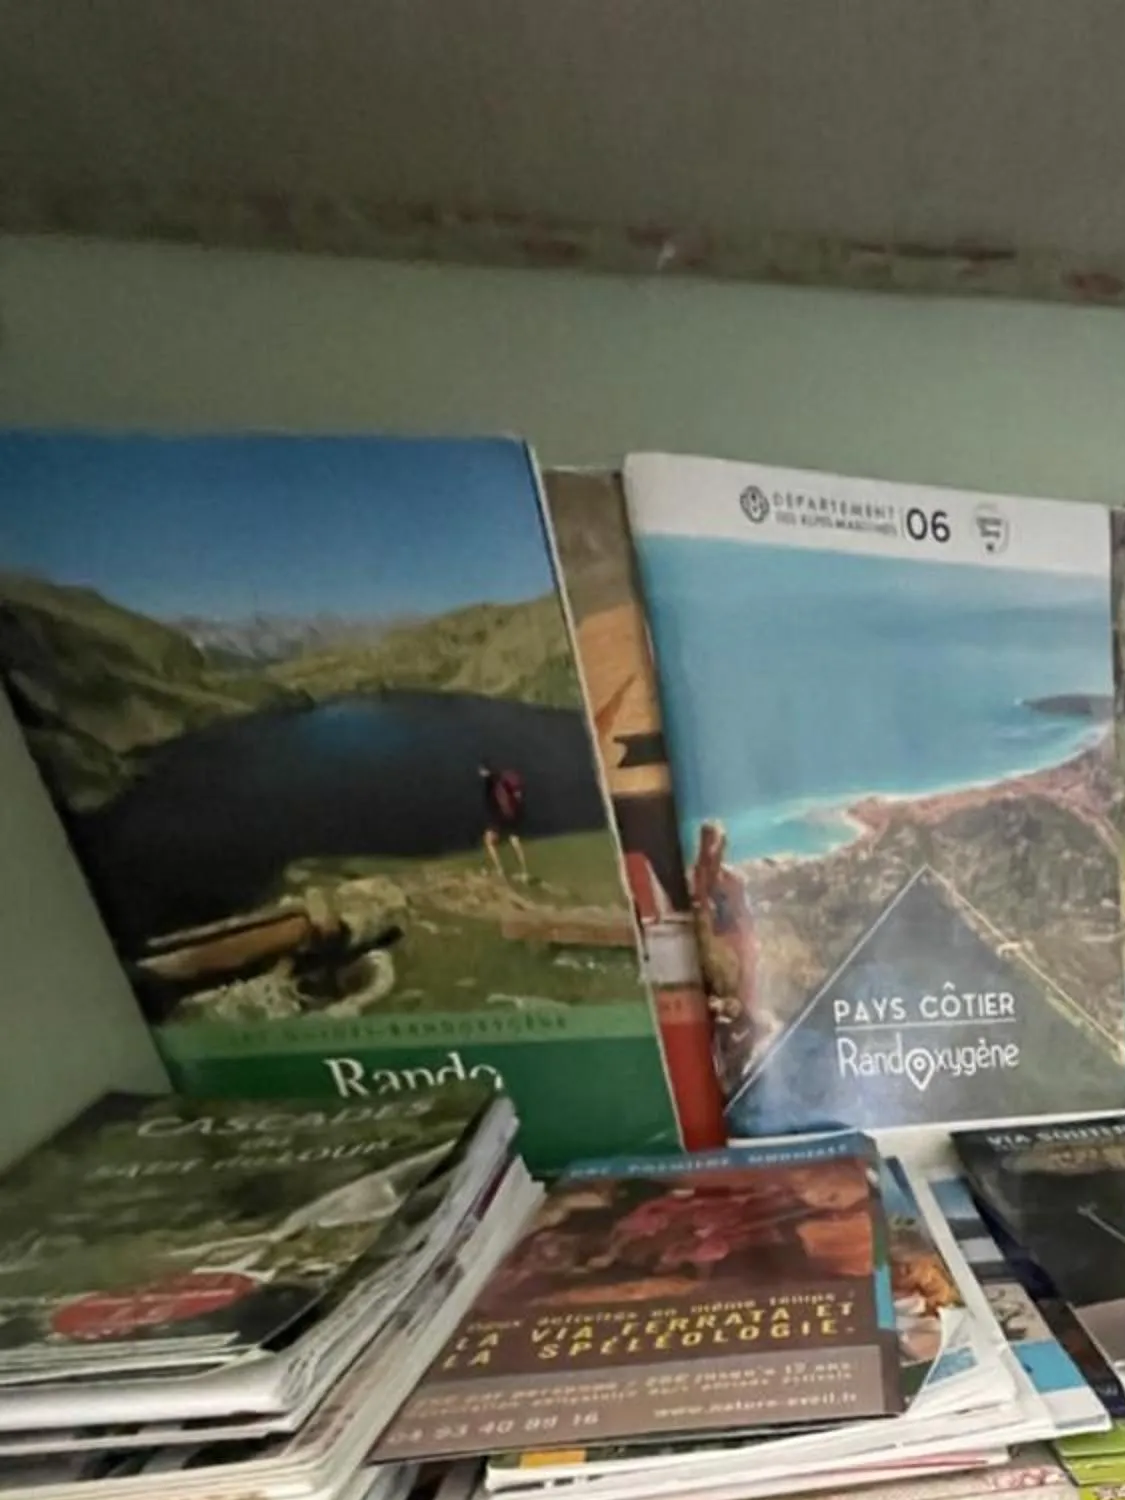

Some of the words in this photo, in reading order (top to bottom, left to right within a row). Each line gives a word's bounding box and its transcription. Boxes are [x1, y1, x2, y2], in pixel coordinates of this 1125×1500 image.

[905, 506, 951, 543] 06
[833, 996, 907, 1025] PAYS
[918, 980, 1016, 1019] CÔTIER
[621, 1307, 791, 1337] FERRATA
[816, 1301, 854, 1318] ET
